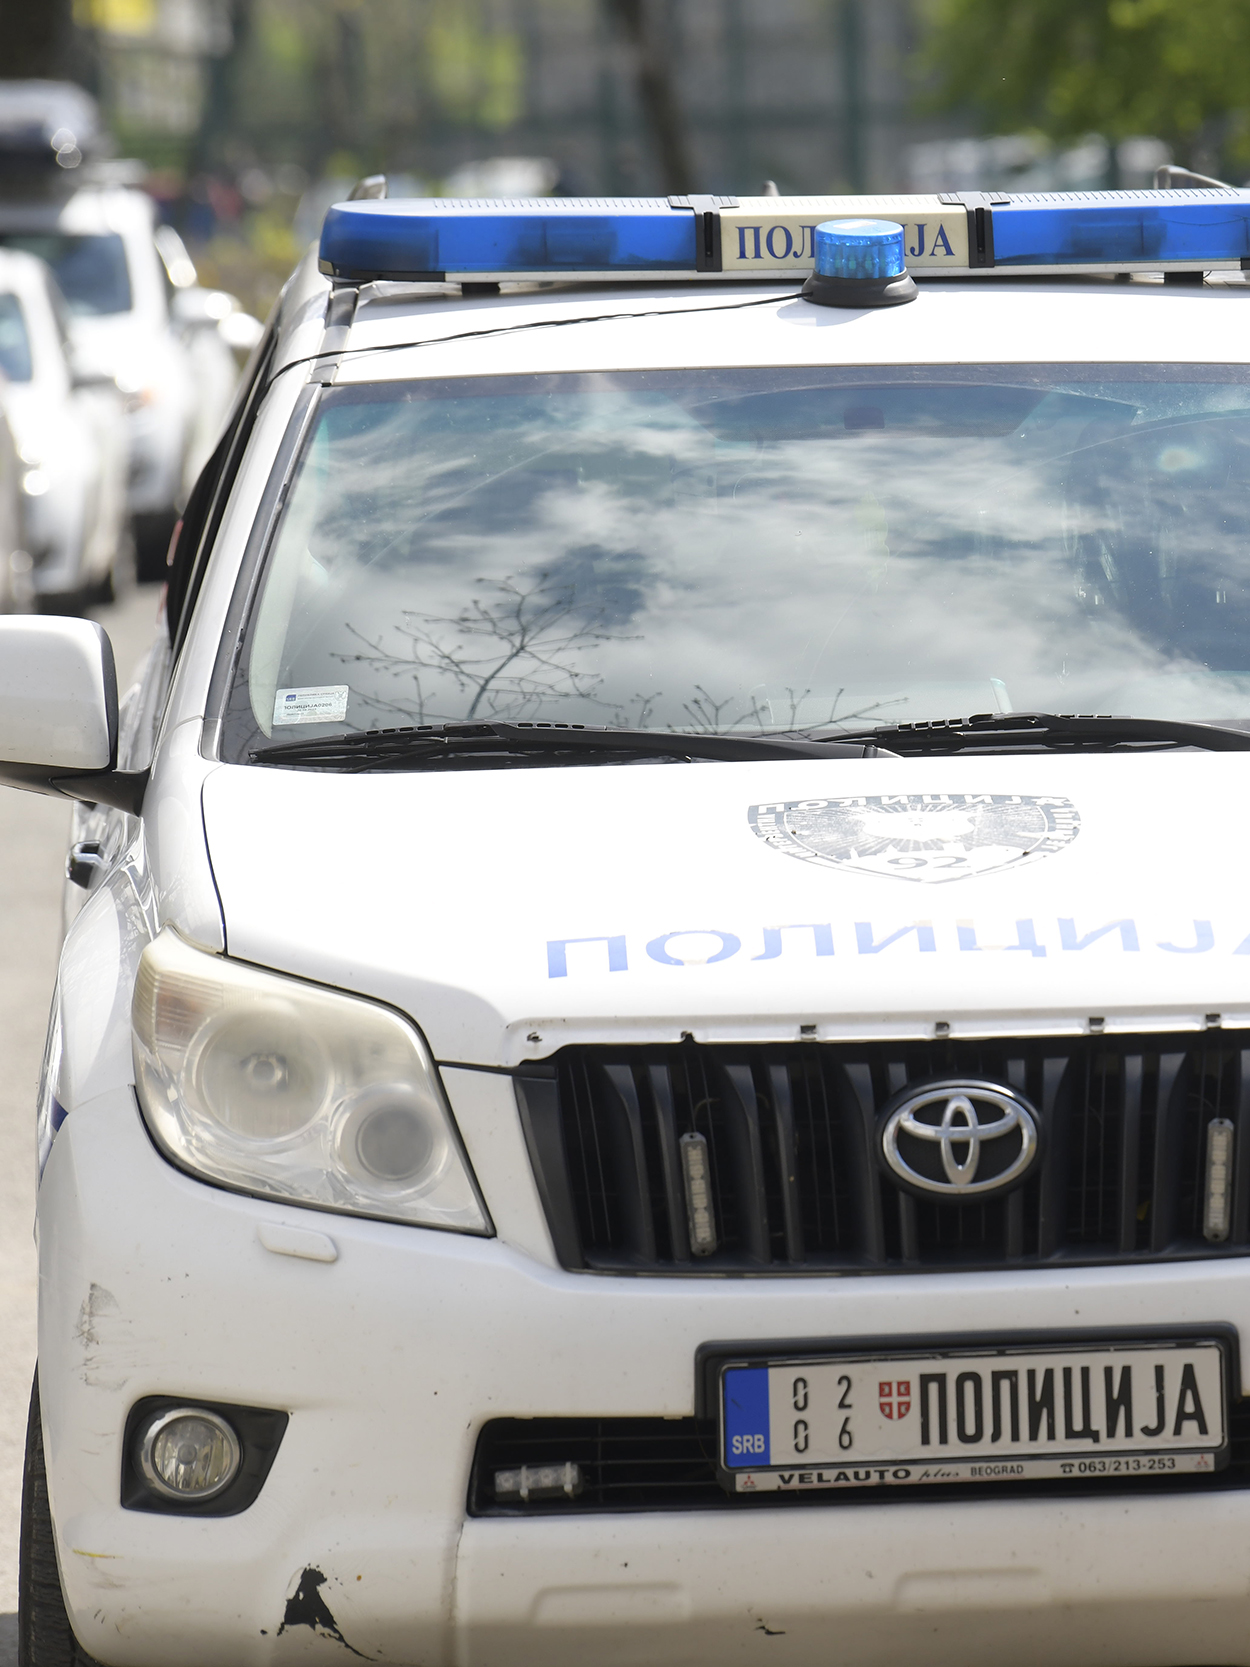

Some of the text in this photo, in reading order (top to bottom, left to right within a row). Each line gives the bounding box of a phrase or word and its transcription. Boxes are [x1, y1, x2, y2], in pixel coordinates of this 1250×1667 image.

[736, 223, 955, 259] ПОЛЈА
[887, 856, 970, 870] 92
[919, 1363, 1209, 1446] ПОЛИЦИЈА
[732, 1434, 765, 1454] SRB
[778, 1457, 1176, 1485] VELAUTO plus BEOGRAD 063/213-253
